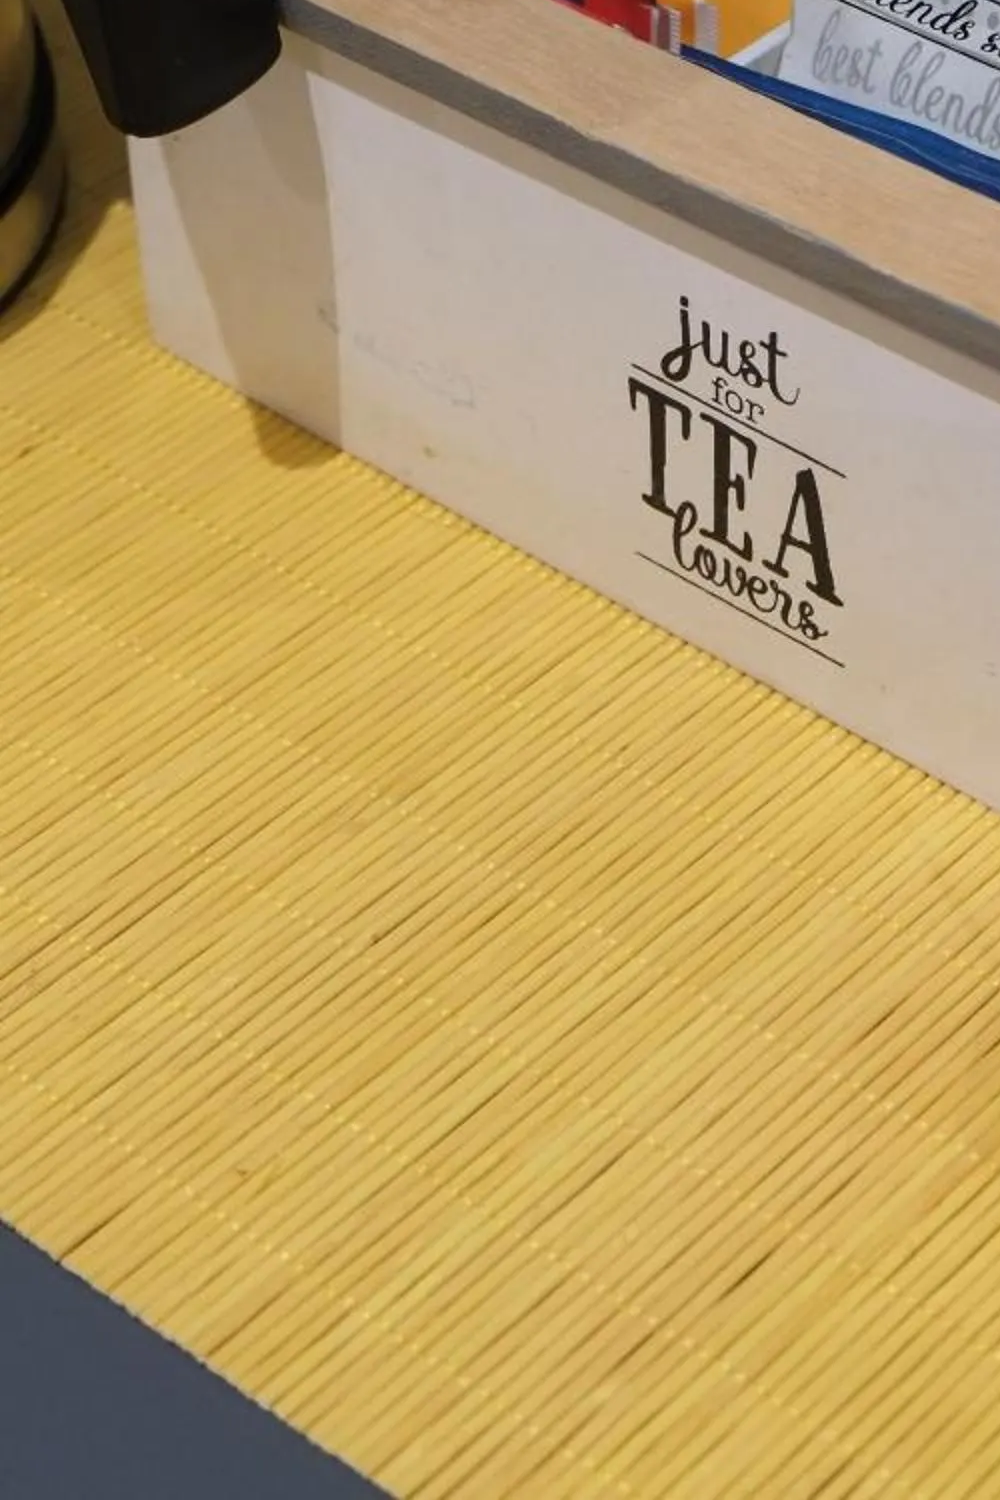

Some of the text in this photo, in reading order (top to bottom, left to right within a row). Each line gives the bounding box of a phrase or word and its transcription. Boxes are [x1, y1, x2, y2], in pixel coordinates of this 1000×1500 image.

[661, 295, 800, 406] just
[711, 376, 765, 423] for
[628, 376, 845, 607] TEA
[673, 500, 828, 641] lovers
